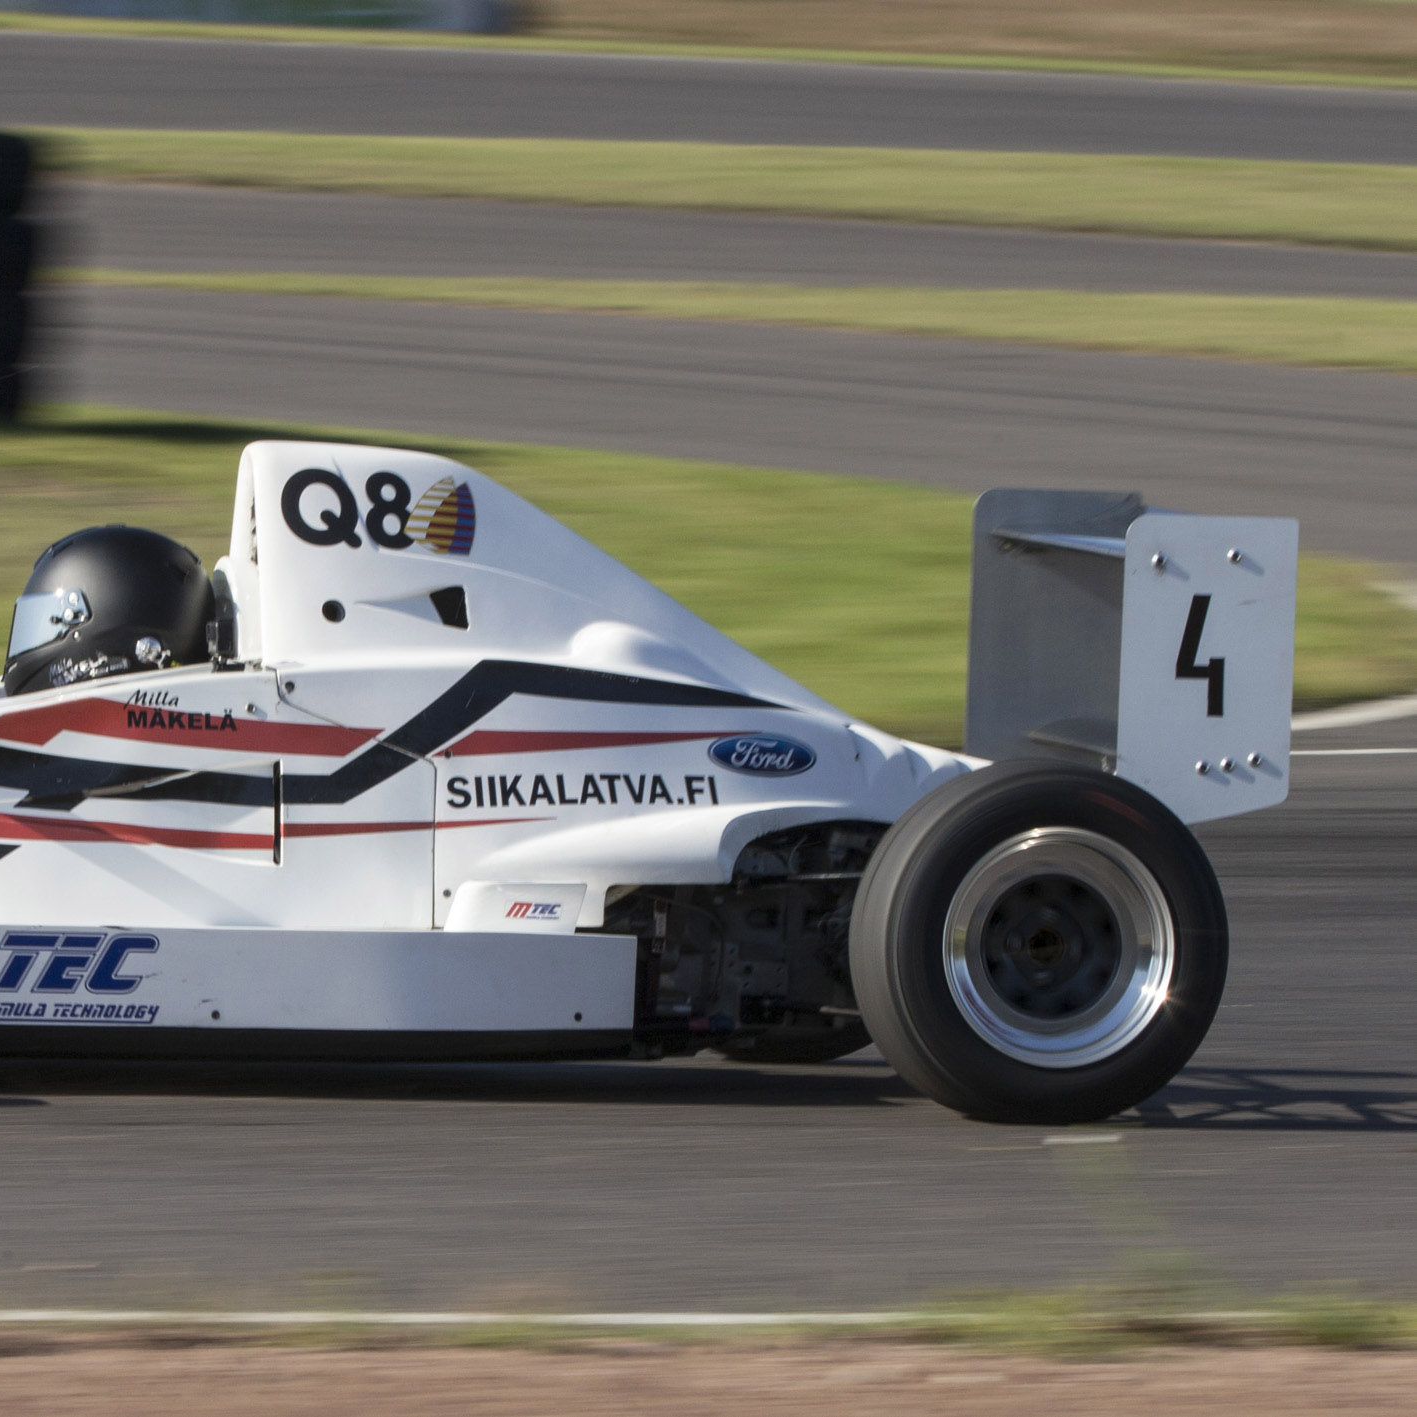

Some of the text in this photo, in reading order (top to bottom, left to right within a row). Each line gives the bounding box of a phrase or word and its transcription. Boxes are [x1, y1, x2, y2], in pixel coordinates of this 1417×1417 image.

[281, 468, 415, 549] Q8
[1176, 594, 1225, 717] 4
[123, 689, 180, 710] Milla
[127, 707, 237, 731] MÄKELÄ
[730, 740, 795, 769] Ford
[446, 773, 719, 808] SIIKALATVA.FI
[505, 902, 562, 918] MTEC
[53, 1003, 159, 1020] TECHNOLOGY
